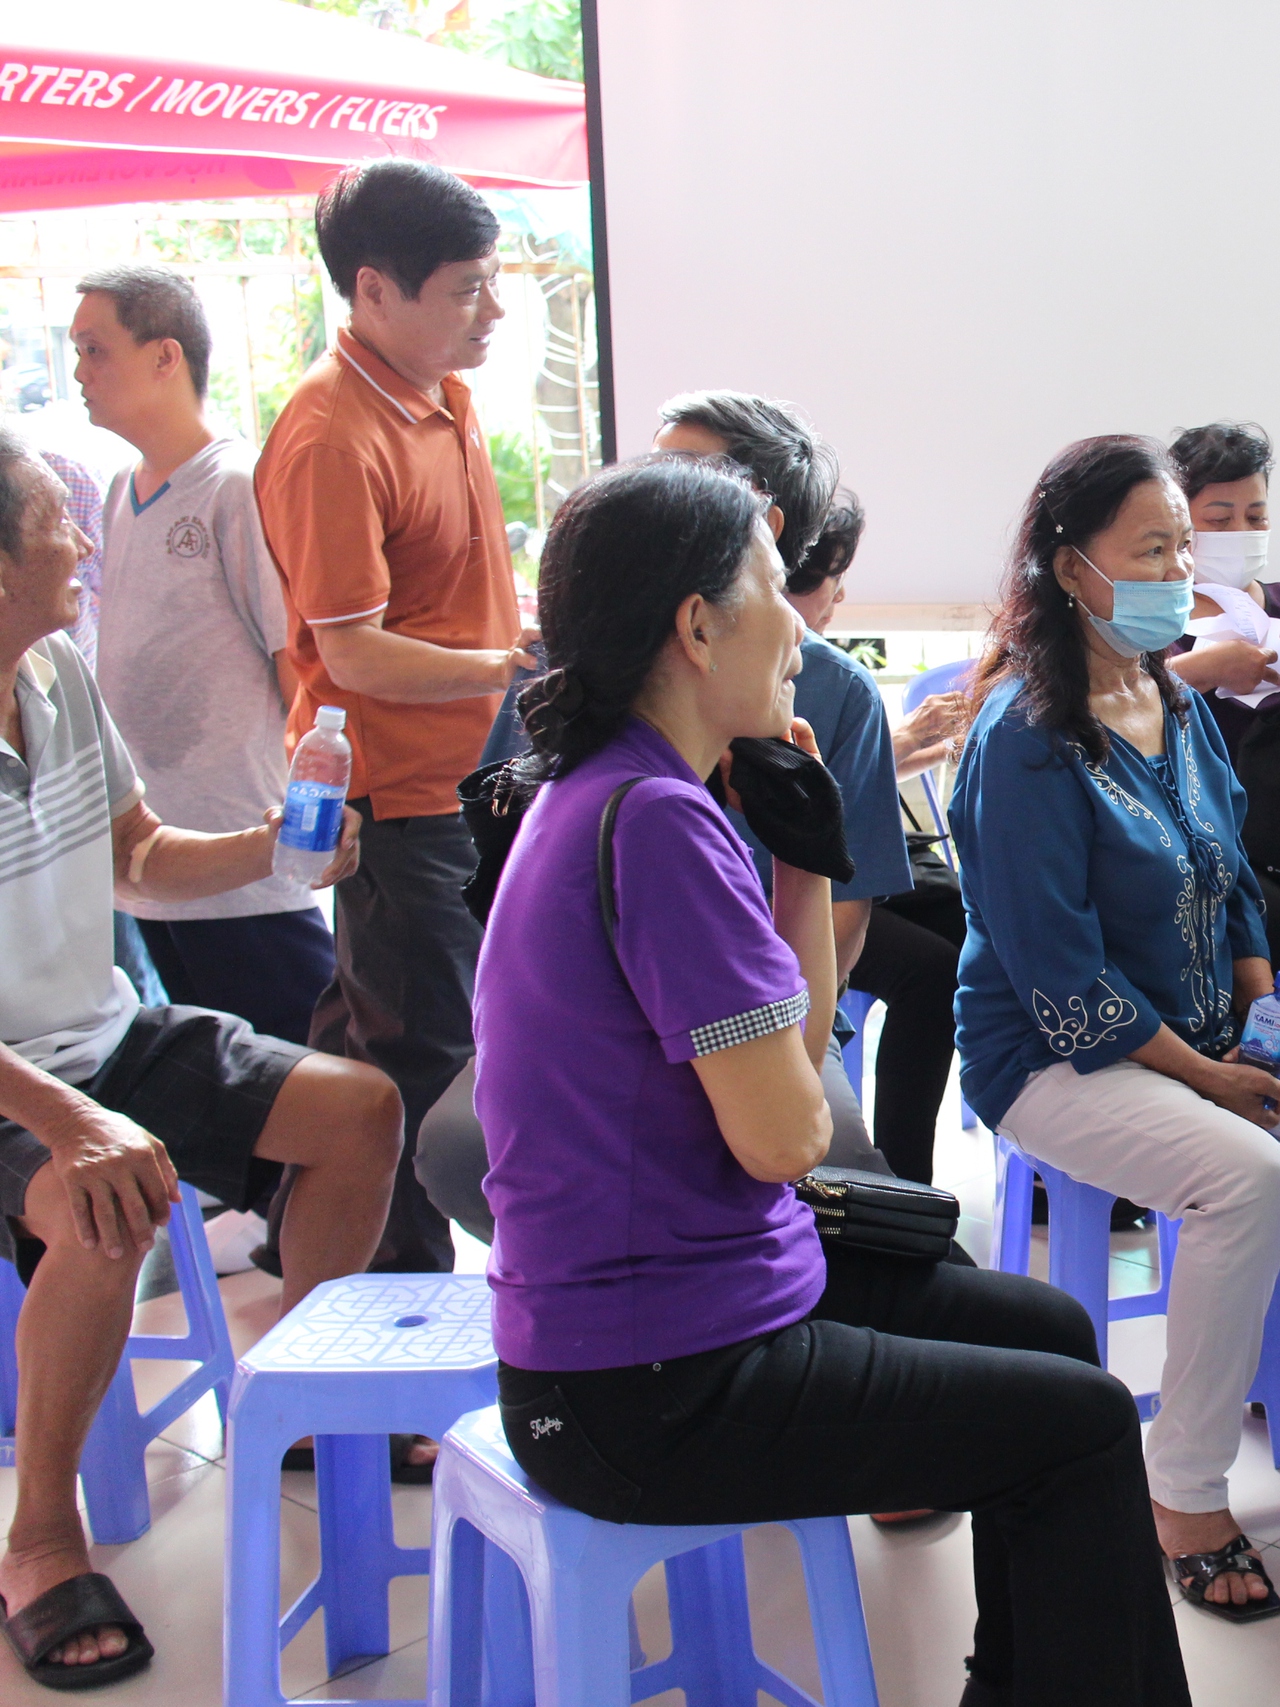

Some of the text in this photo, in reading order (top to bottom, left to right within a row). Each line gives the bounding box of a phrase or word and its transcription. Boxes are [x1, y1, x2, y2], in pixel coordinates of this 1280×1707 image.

[150, 78, 320, 125] MOVERS
[330, 97, 447, 140] FLYERS
[1254, 1013, 1275, 1026] KAMI
